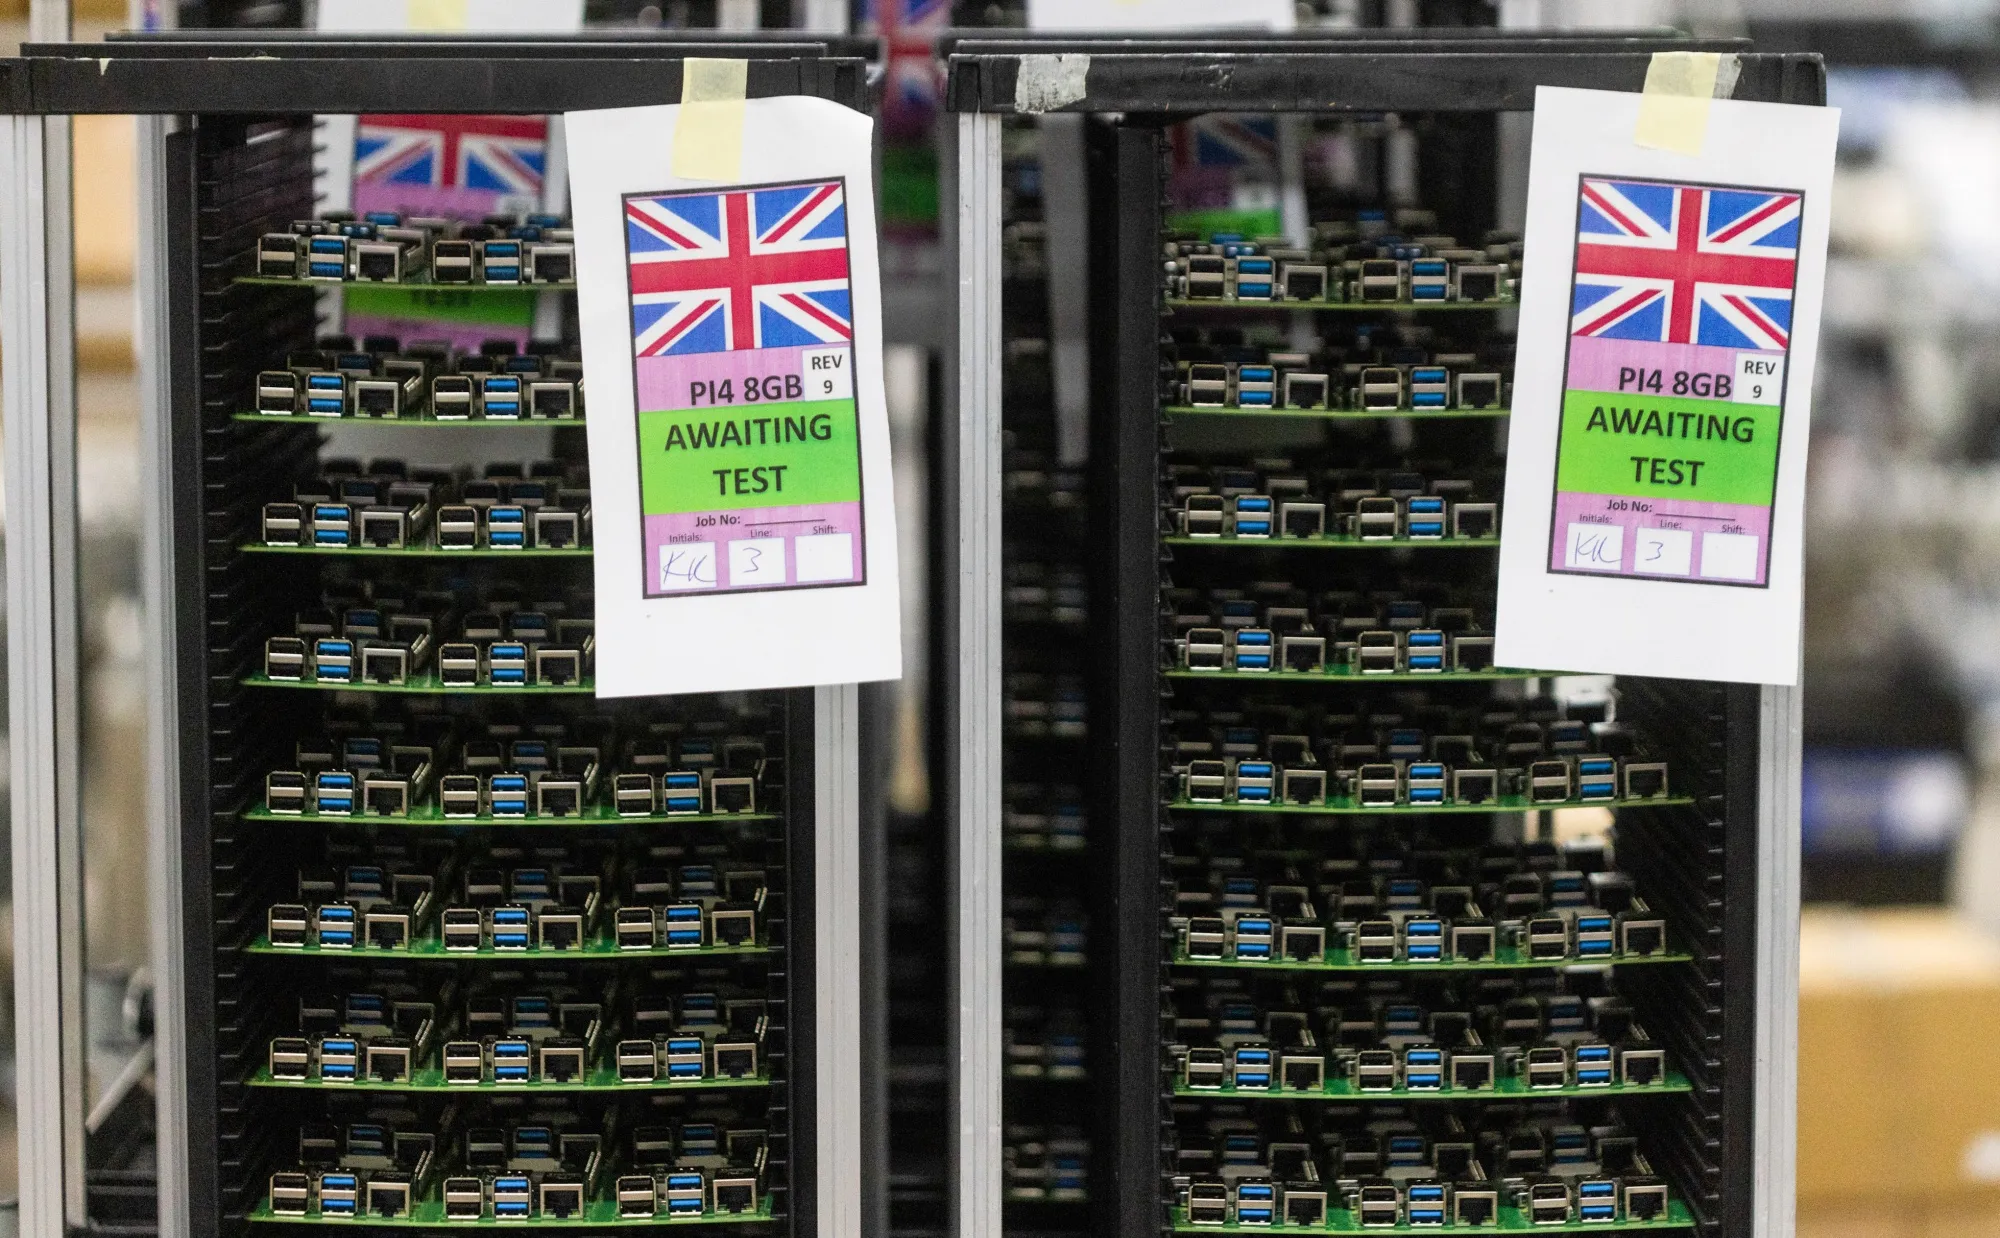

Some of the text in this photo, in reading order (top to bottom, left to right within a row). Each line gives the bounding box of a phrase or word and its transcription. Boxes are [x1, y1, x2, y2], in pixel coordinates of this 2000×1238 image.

[811, 355, 843, 370] REV
[1744, 360, 1776, 376] REV
[690, 375, 803, 405] PI4 8GB
[823, 380, 833, 394] 9
[1618, 367, 1732, 398] PI4 8GB
[1752, 385, 1762, 399] 9
[1586, 405, 1756, 443] AWAITING
[664, 414, 833, 451] AWAITING
[1630, 456, 1705, 486] TEST
[713, 465, 788, 496] TEST
[1606, 500, 1653, 513] Job No:
[695, 513, 741, 528] Job No:
[1579, 513, 1613, 524] Initials:
[1660, 519, 1682, 529] Line:
[750, 528, 772, 538] Line:
[812, 525, 838, 535] Shift:
[1721, 524, 1746, 535] Shift:
[669, 533, 703, 543] Initials:
[1645, 541, 1664, 561] 3
[742, 547, 762, 573] 3
